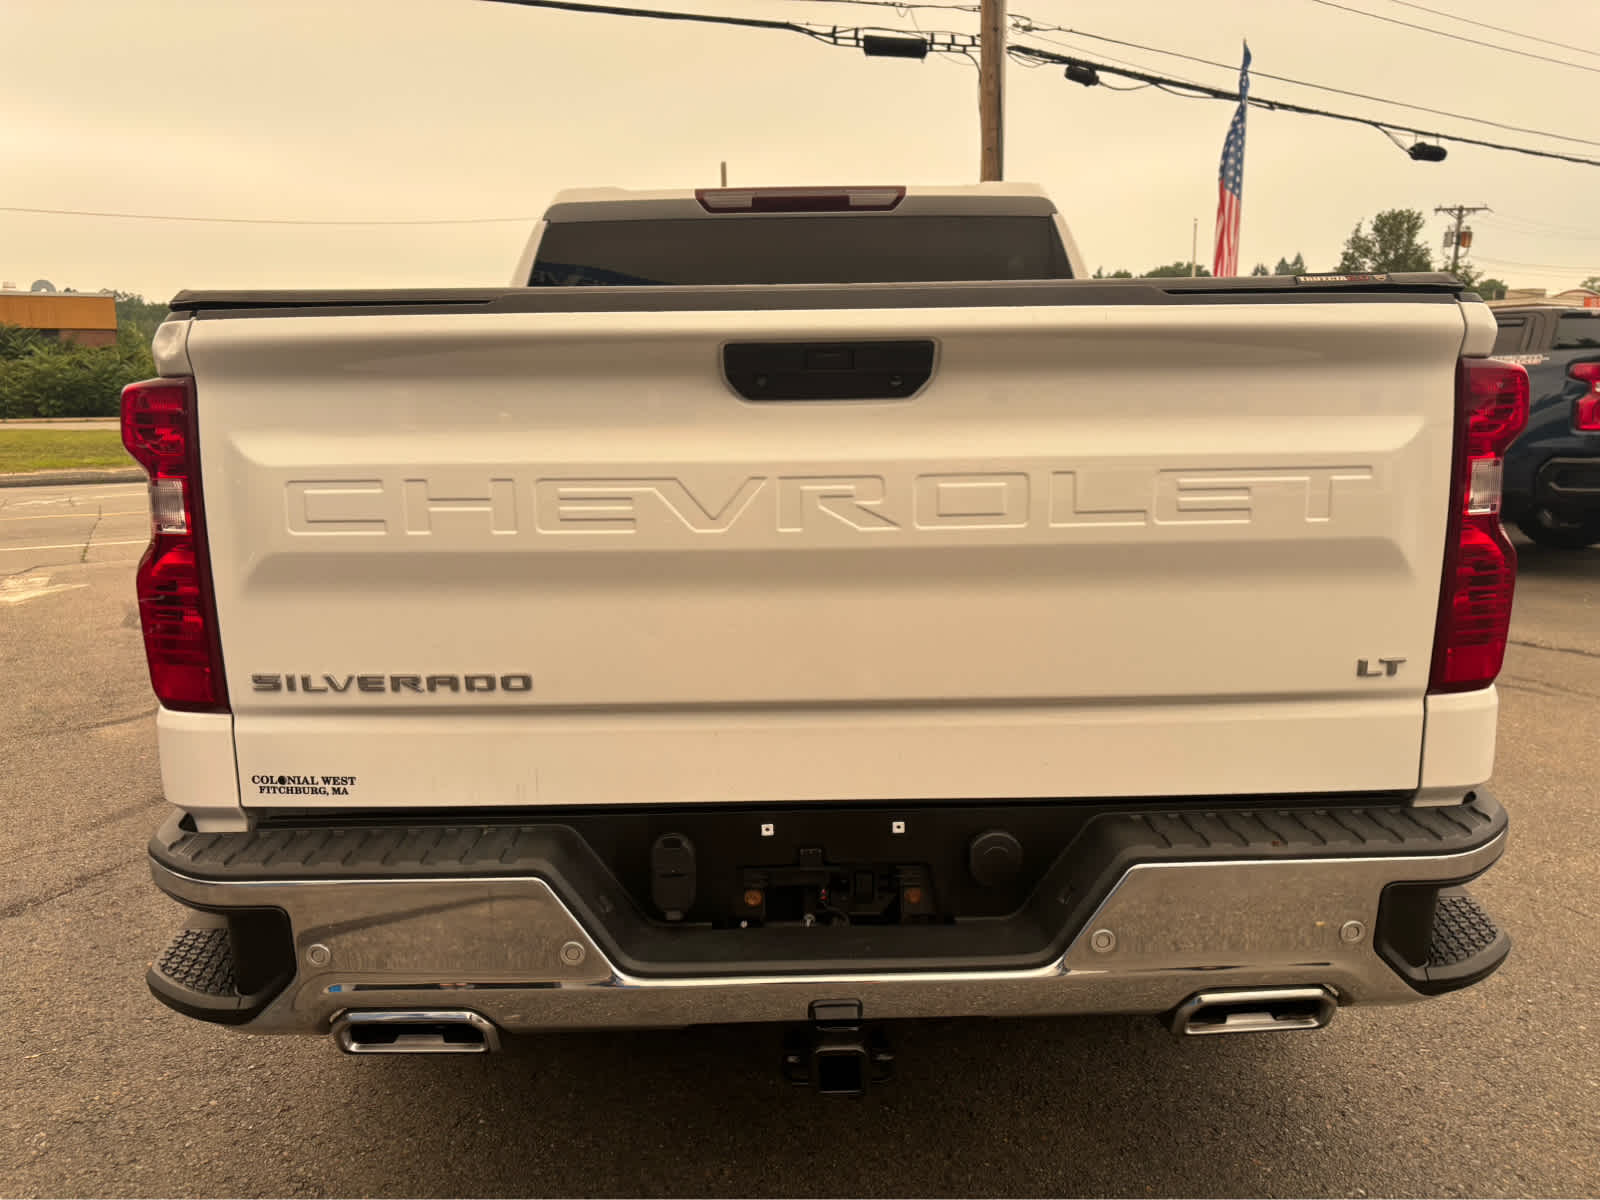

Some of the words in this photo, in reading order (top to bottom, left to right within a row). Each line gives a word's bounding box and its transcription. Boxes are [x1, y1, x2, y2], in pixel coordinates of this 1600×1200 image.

[285, 466, 1373, 536] CHEVROLET
[1356, 657, 1407, 677] LT
[251, 674, 533, 693] SILVERADO
[251, 775, 319, 785] COLONIAL
[321, 776, 356, 786] WEST
[259, 785, 330, 796] FITCHBURG,
[332, 787, 349, 796] MA
